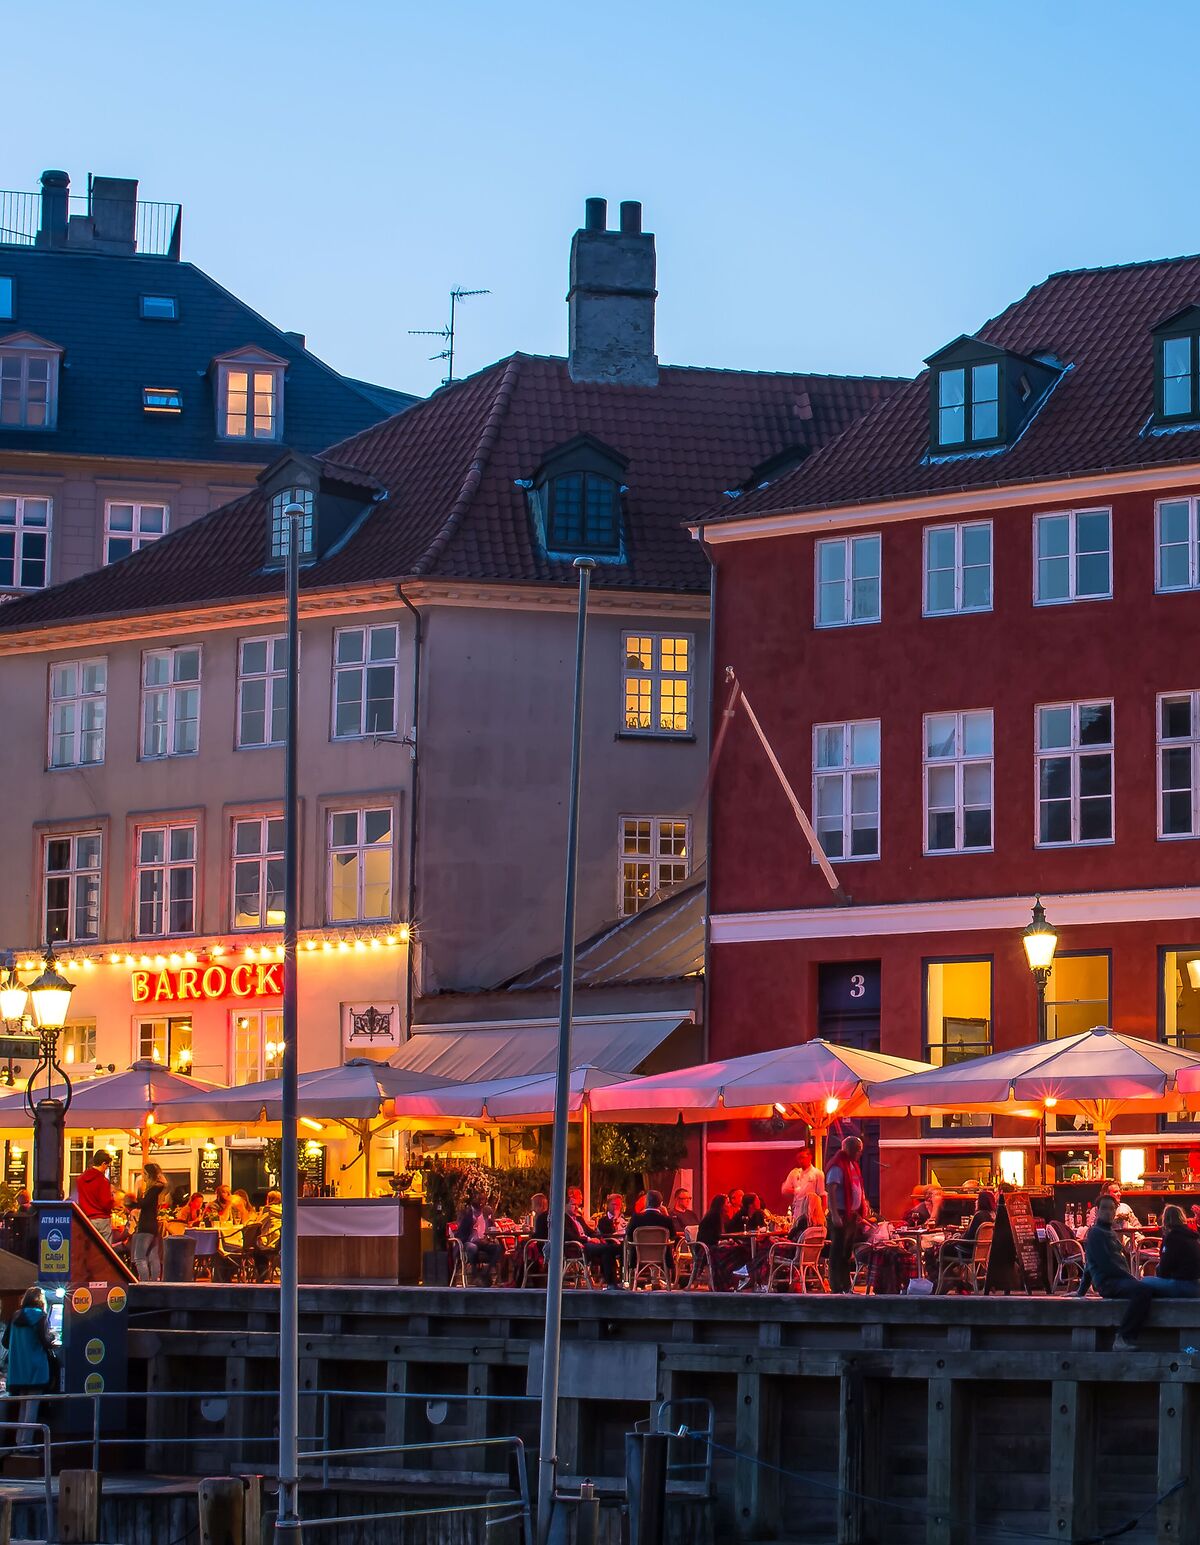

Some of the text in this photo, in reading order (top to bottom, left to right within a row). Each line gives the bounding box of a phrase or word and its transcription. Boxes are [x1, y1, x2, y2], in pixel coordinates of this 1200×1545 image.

[131, 964, 282, 1002] BAROCK
[850, 974, 865, 997] 3
[201, 1160, 220, 1170] Coffee
[41, 1216, 70, 1224] ATM HERE
[45, 1253, 64, 1261] CASH
[74, 1296, 89, 1305] DKK
[110, 1295, 126, 1304] EUR
